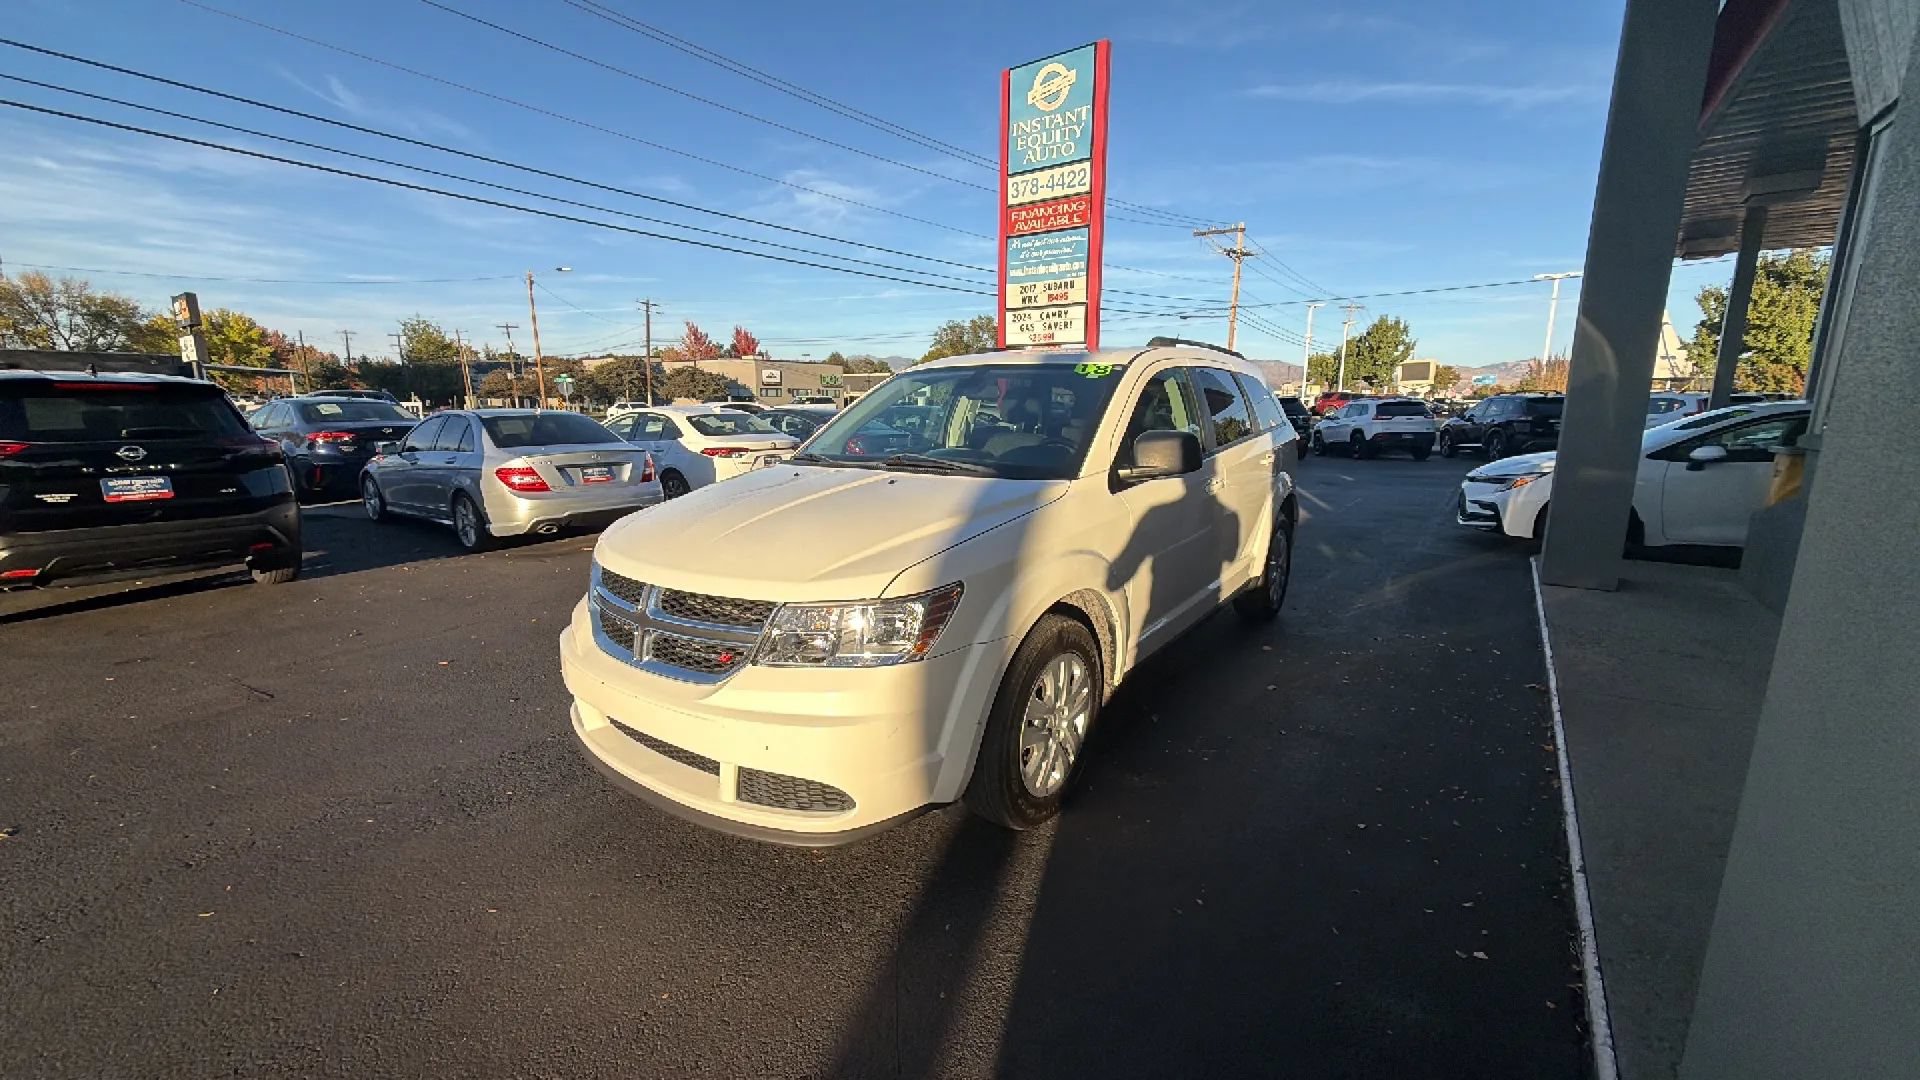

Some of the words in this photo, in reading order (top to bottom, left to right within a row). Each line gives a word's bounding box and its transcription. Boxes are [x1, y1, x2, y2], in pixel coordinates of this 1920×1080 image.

[1012, 104, 1091, 137] INSTANT
[1016, 122, 1085, 151] EQUITY
[1023, 141, 1075, 165] AUTO
[1011, 167, 1088, 199] 378-4422
[1011, 201, 1087, 222] FINANCING
[1014, 211, 1083, 233] AVAILABLE
[1019, 284, 1037, 295] 2017
[1042, 280, 1075, 292] SUBARU
[1019, 323, 1035, 332] GAS
[1042, 321, 1073, 331] SAVER!
[1039, 310, 1069, 321] CAMRY
